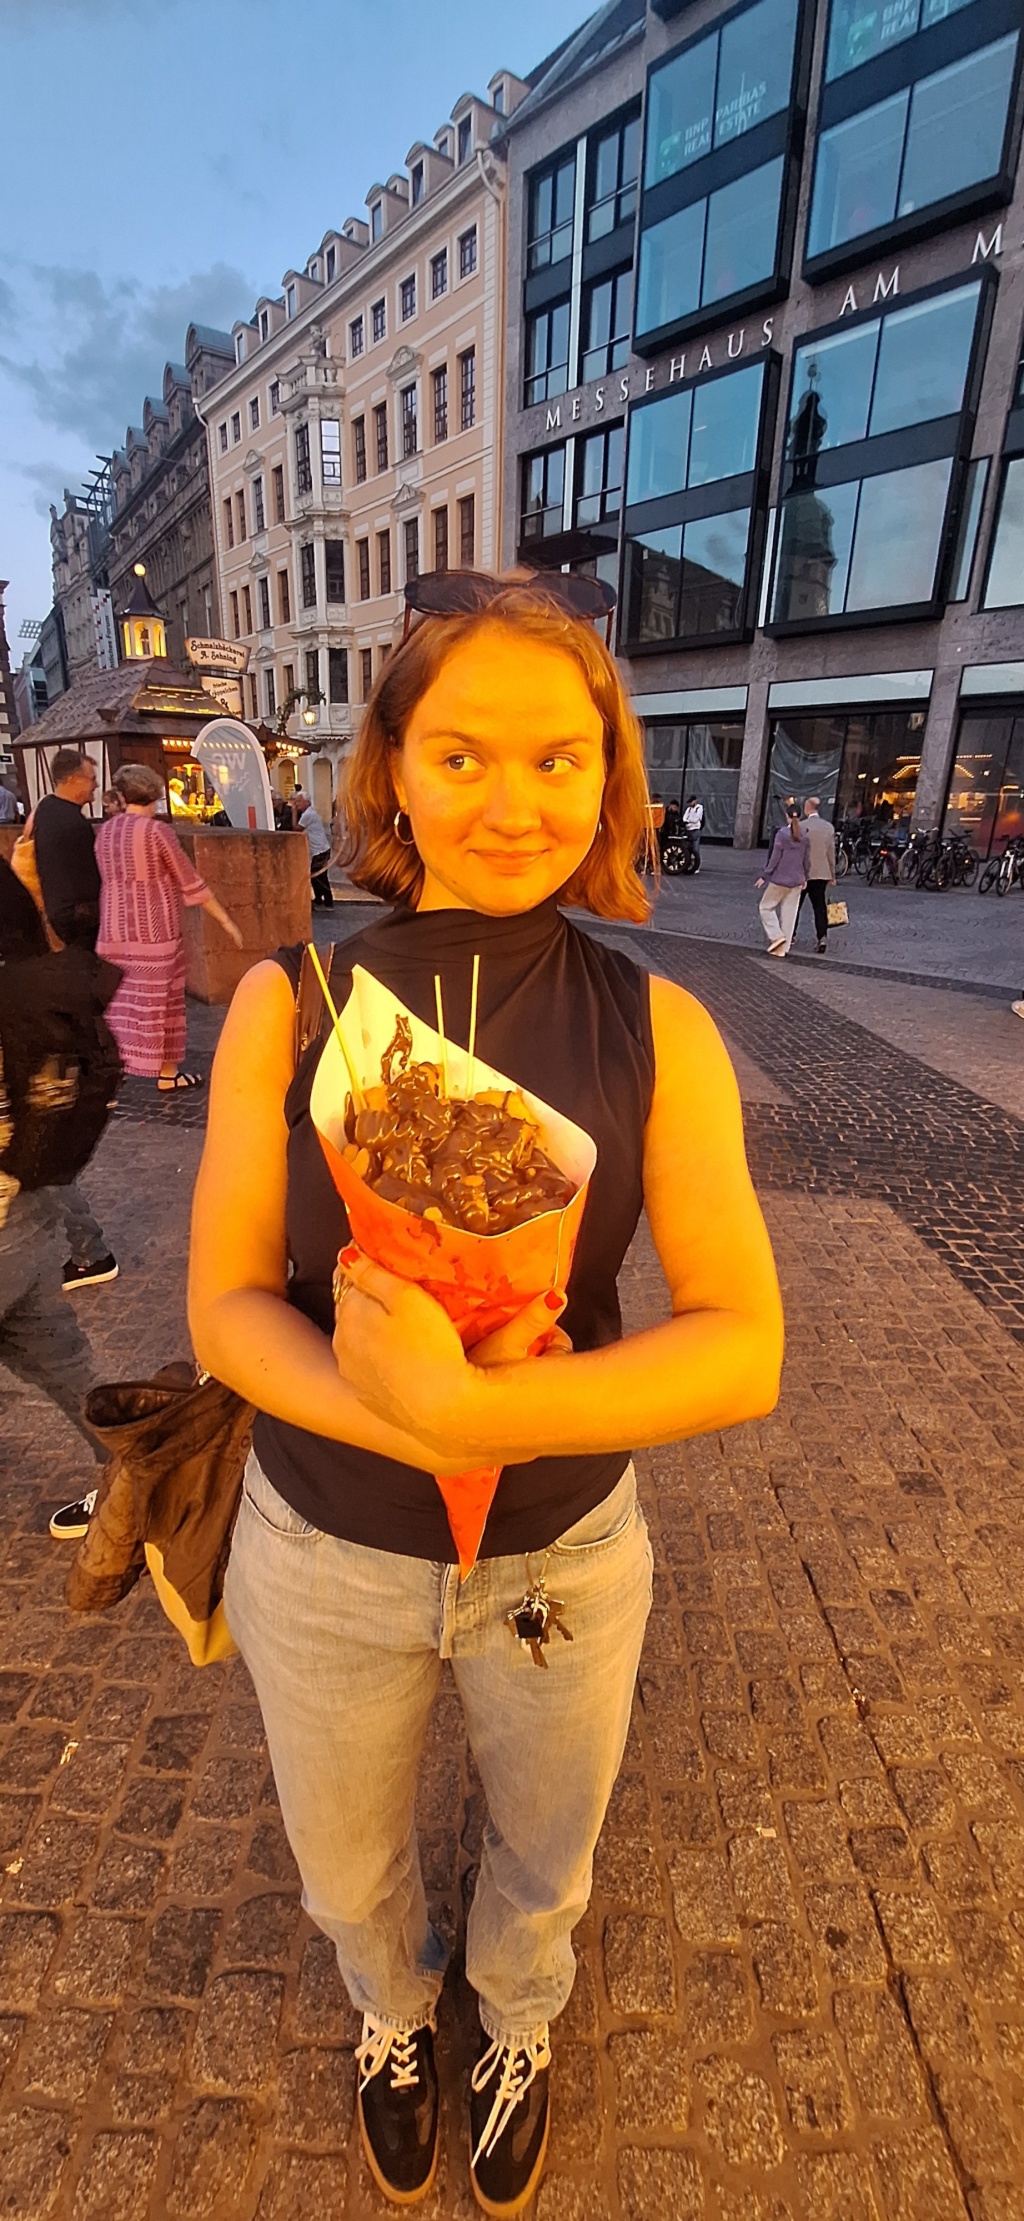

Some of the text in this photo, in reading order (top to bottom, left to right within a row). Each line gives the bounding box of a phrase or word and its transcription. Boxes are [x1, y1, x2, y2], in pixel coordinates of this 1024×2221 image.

[881, 8, 916, 40] REAL
[684, 100, 761, 156] REAL ESTATE
[685, 81, 766, 141] BNP PARIBAS
[545, 318, 774, 430] MESSEHAUS
[838, 265, 900, 317] AM
[190, 640, 245, 658] Schmalzbäckerei
